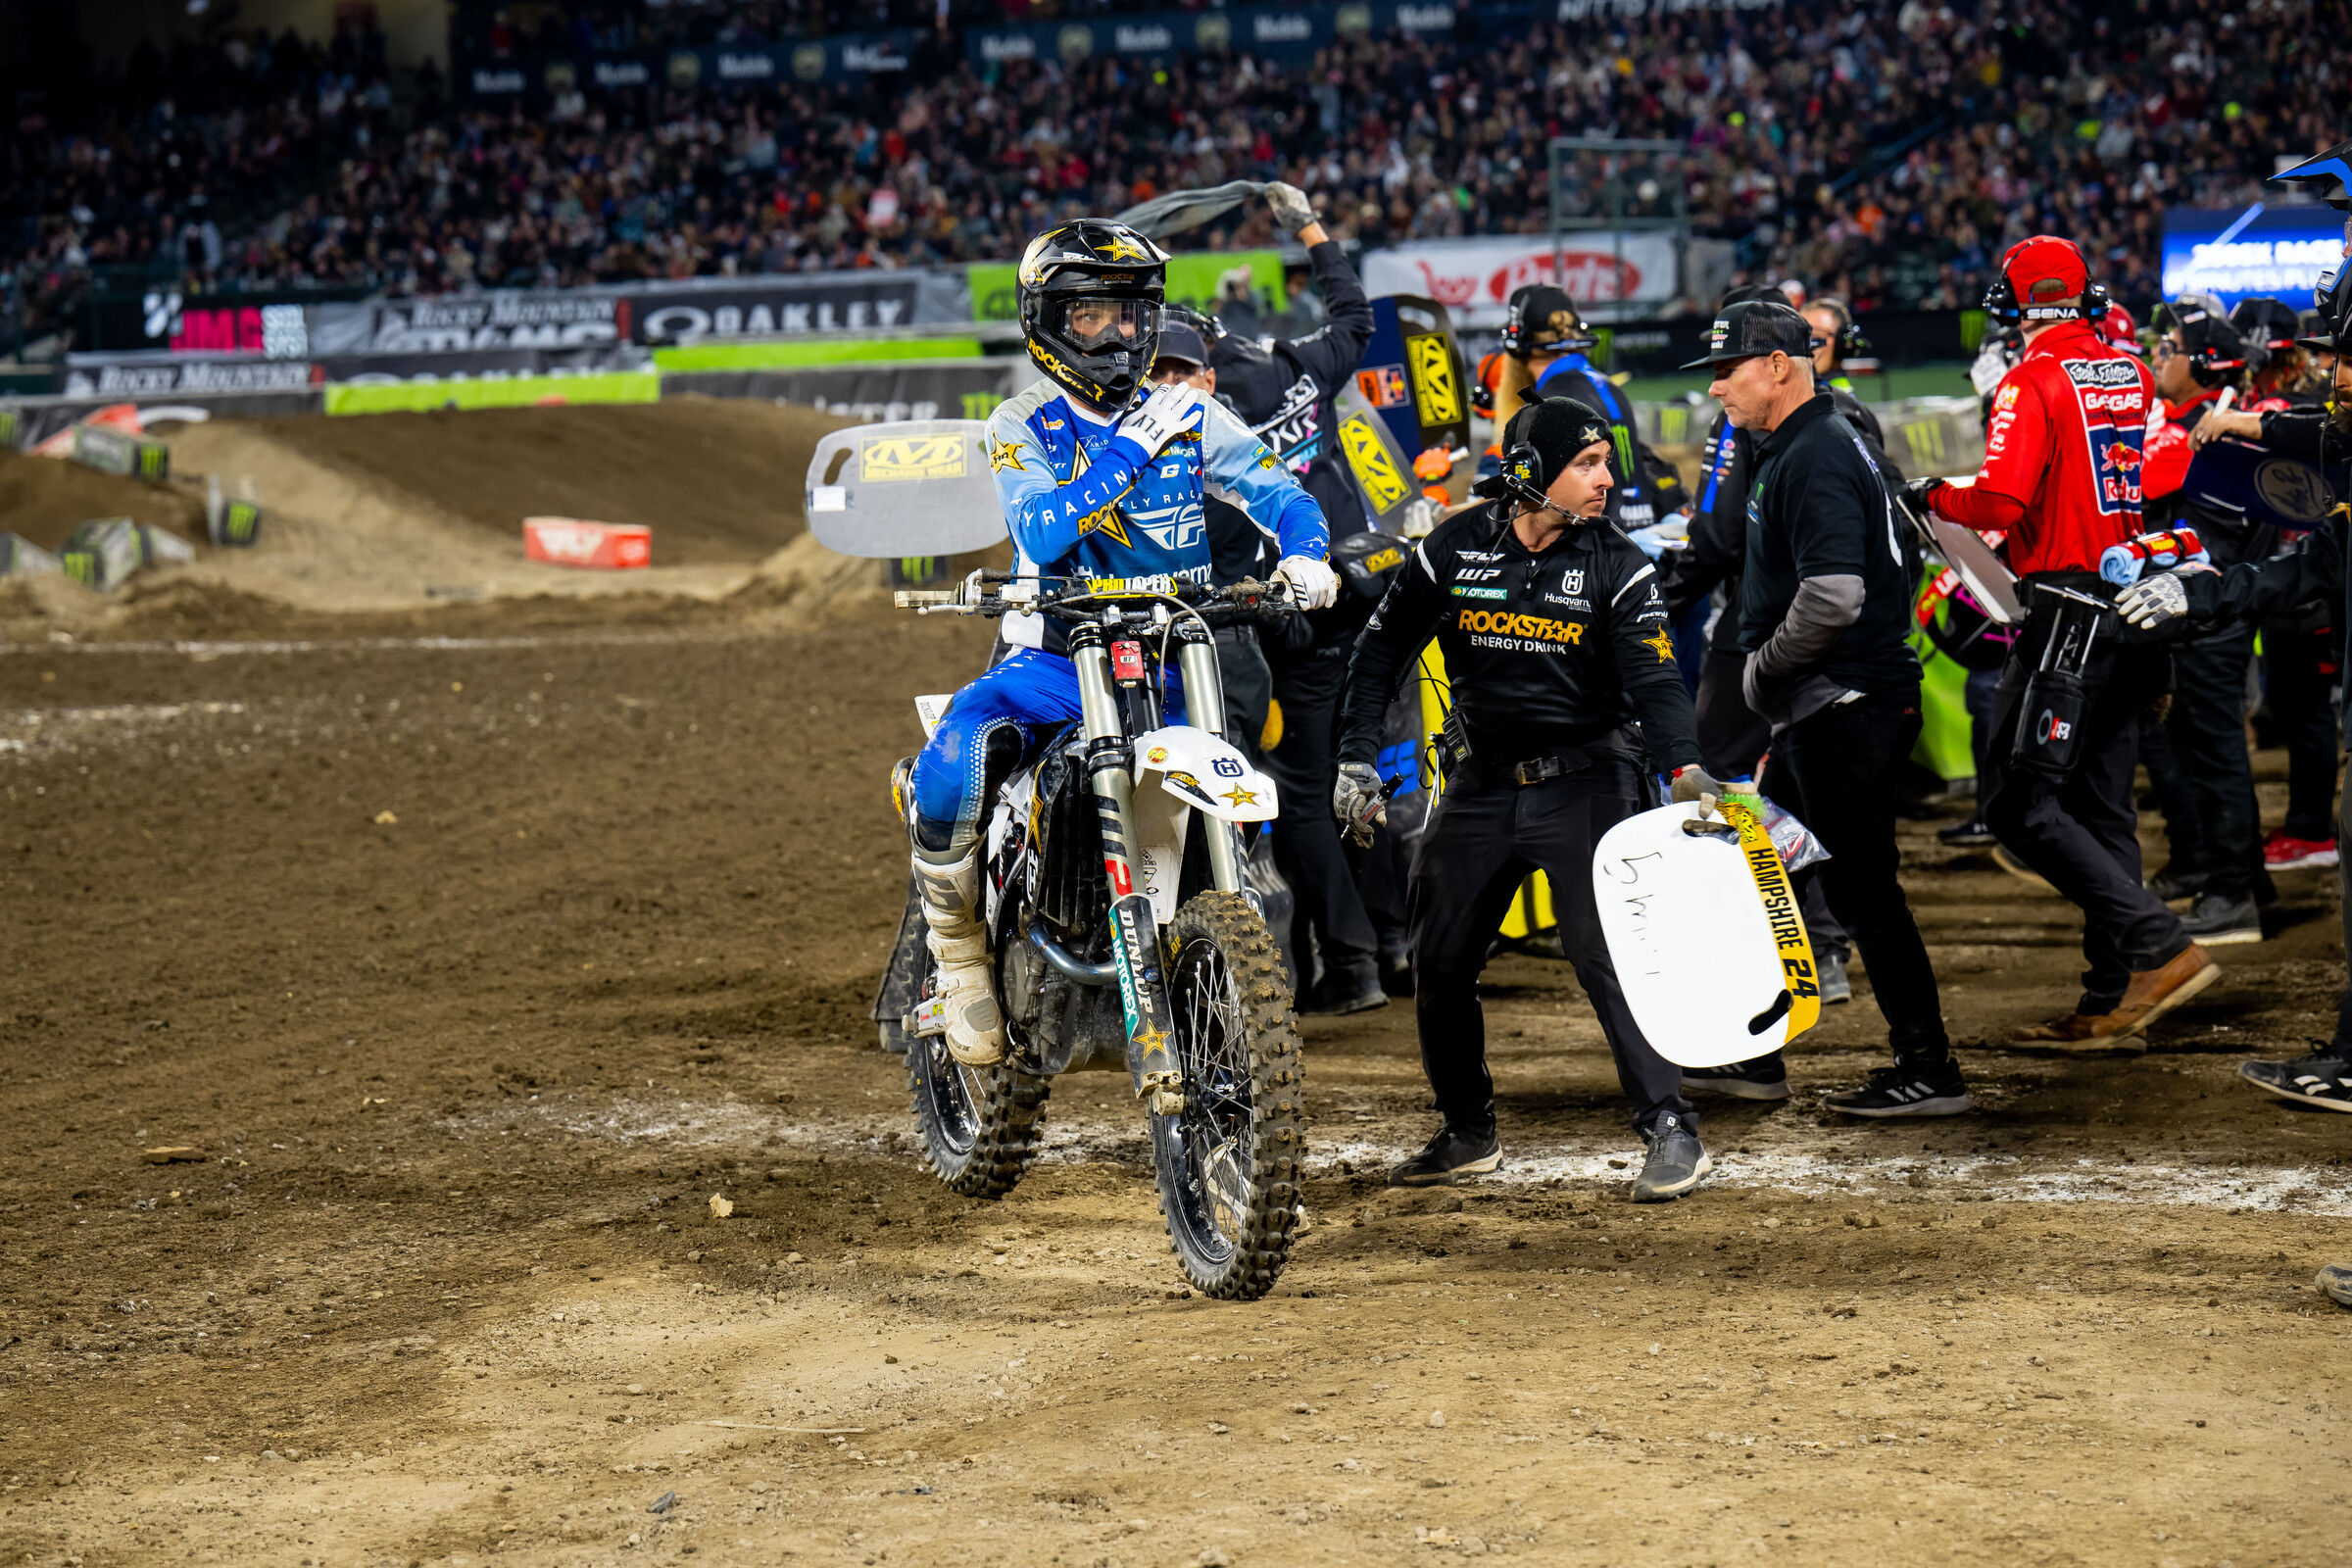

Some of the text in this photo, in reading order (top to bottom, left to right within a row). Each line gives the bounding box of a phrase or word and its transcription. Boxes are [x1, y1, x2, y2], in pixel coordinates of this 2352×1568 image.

[714, 299, 905, 334] OAKLEY
[2027, 308, 2080, 319] SENA
[1132, 414, 1164, 442] FLY
[1118, 494, 1151, 510] FLY
[1462, 588, 1507, 600] MOTOREX
[1458, 609, 1584, 645] ROCKSTAR
[1471, 635, 1567, 655] ENERGY DRINK
[1748, 848, 1820, 999] HAMPSHIRE 24
[1119, 910, 1153, 1014] DUNLOP
[1112, 940, 1138, 1021] MOTOREX
[1215, 1083, 1235, 1093] 24
